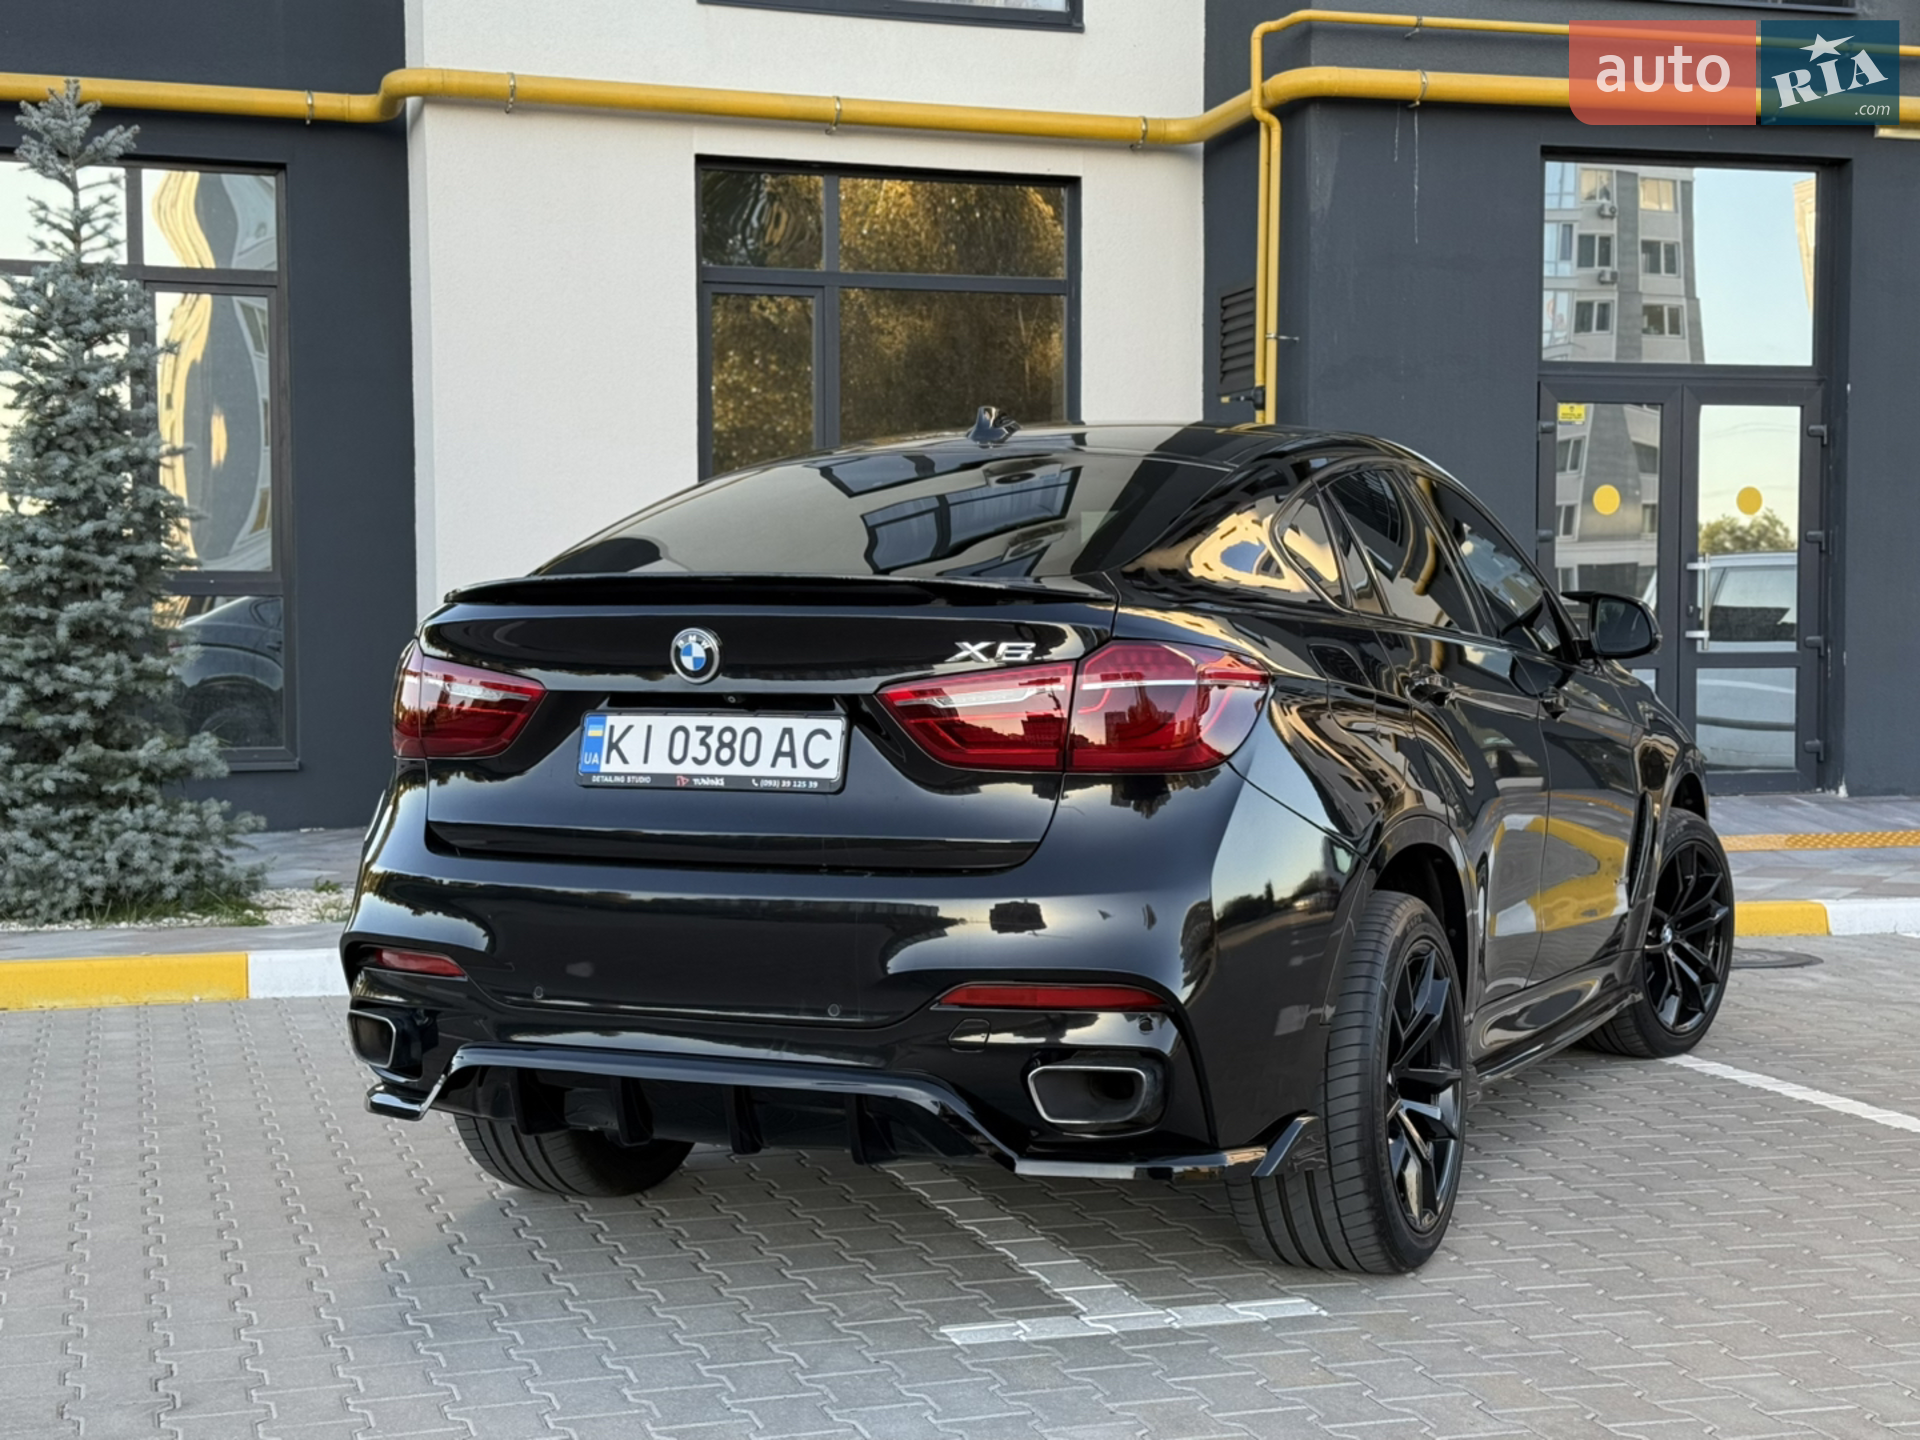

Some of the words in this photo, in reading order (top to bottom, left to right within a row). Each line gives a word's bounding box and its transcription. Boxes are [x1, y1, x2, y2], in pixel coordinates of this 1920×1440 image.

[676, 634, 712, 650] BMW
[944, 641, 1036, 663] X6
[605, 724, 652, 765] KI
[668, 725, 762, 768] 0380
[770, 727, 833, 769] AC
[583, 752, 600, 765] UA
[592, 775, 625, 784] DETAILING
[627, 775, 652, 784] STUDIO
